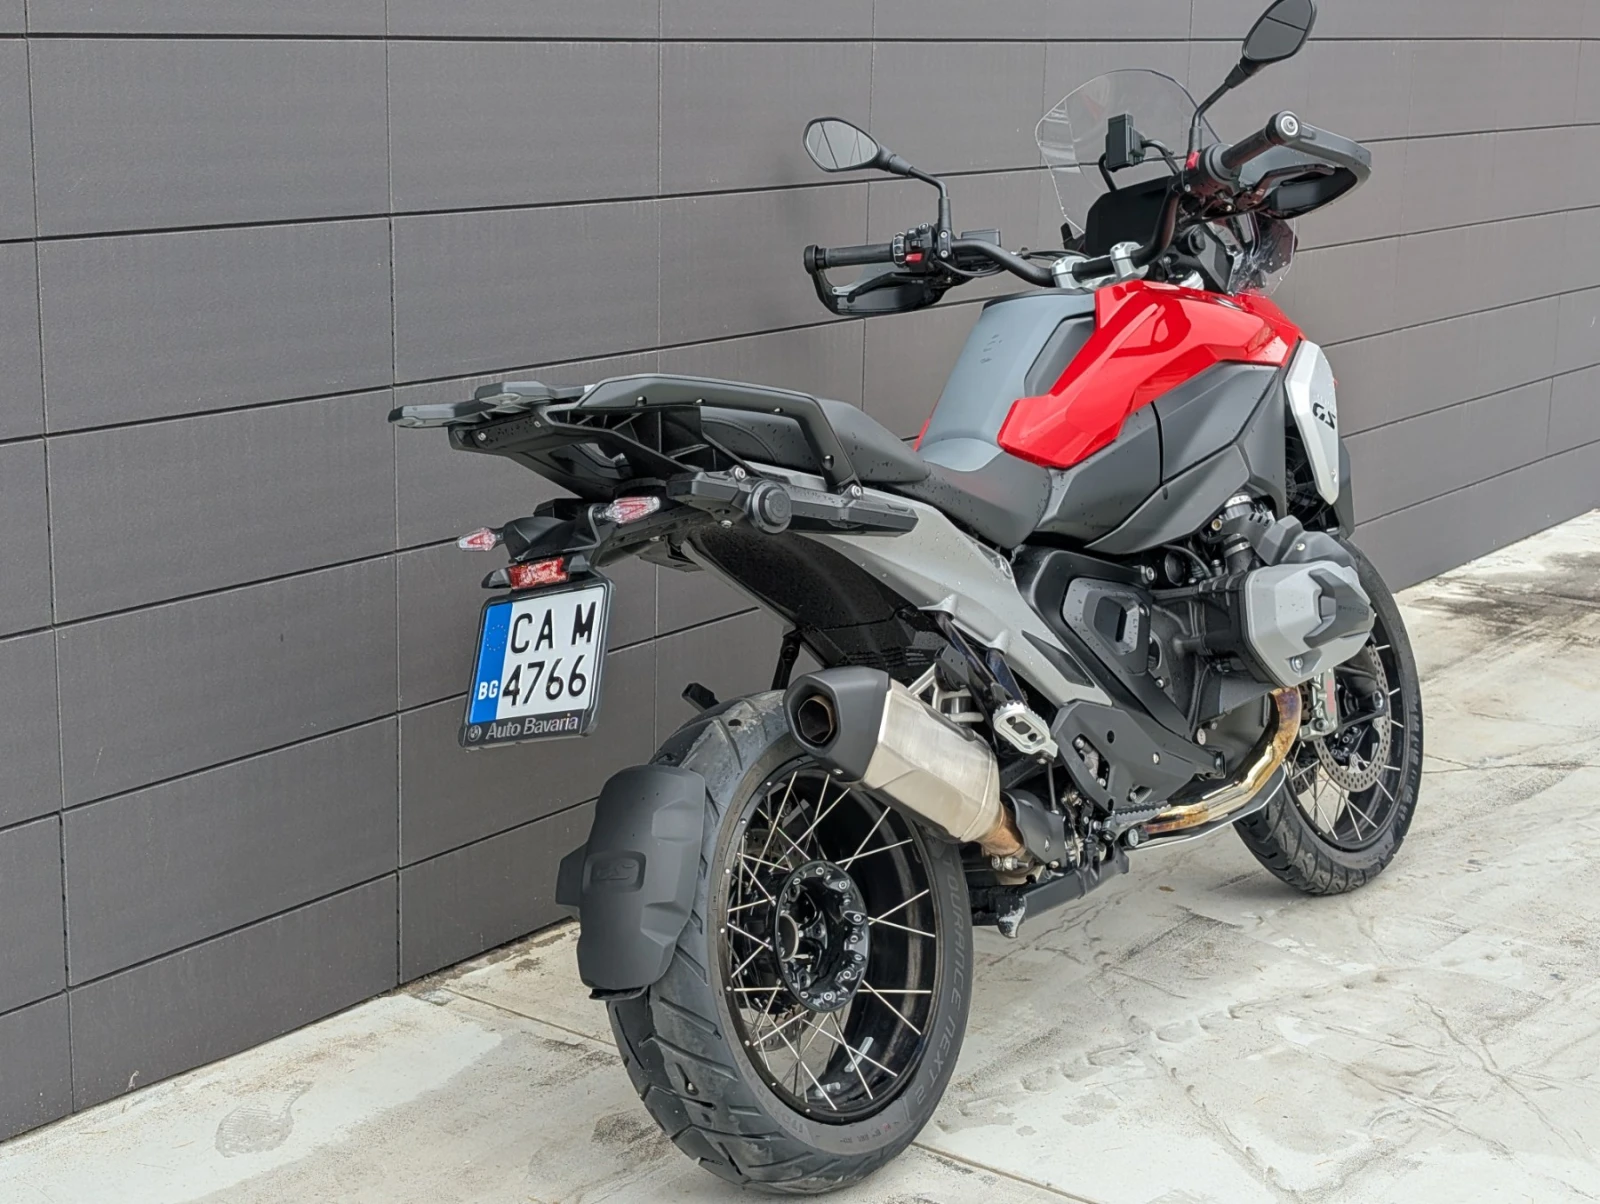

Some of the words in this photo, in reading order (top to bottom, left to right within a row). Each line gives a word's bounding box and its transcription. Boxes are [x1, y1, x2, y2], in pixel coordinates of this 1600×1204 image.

[1312, 402, 1336, 430] GS
[510, 608, 554, 654] CA
[571, 601, 597, 646] M
[477, 680, 499, 700] BG
[502, 654, 587, 707] 4766
[485, 721, 521, 741] Auto
[523, 713, 579, 736] Bavaria
